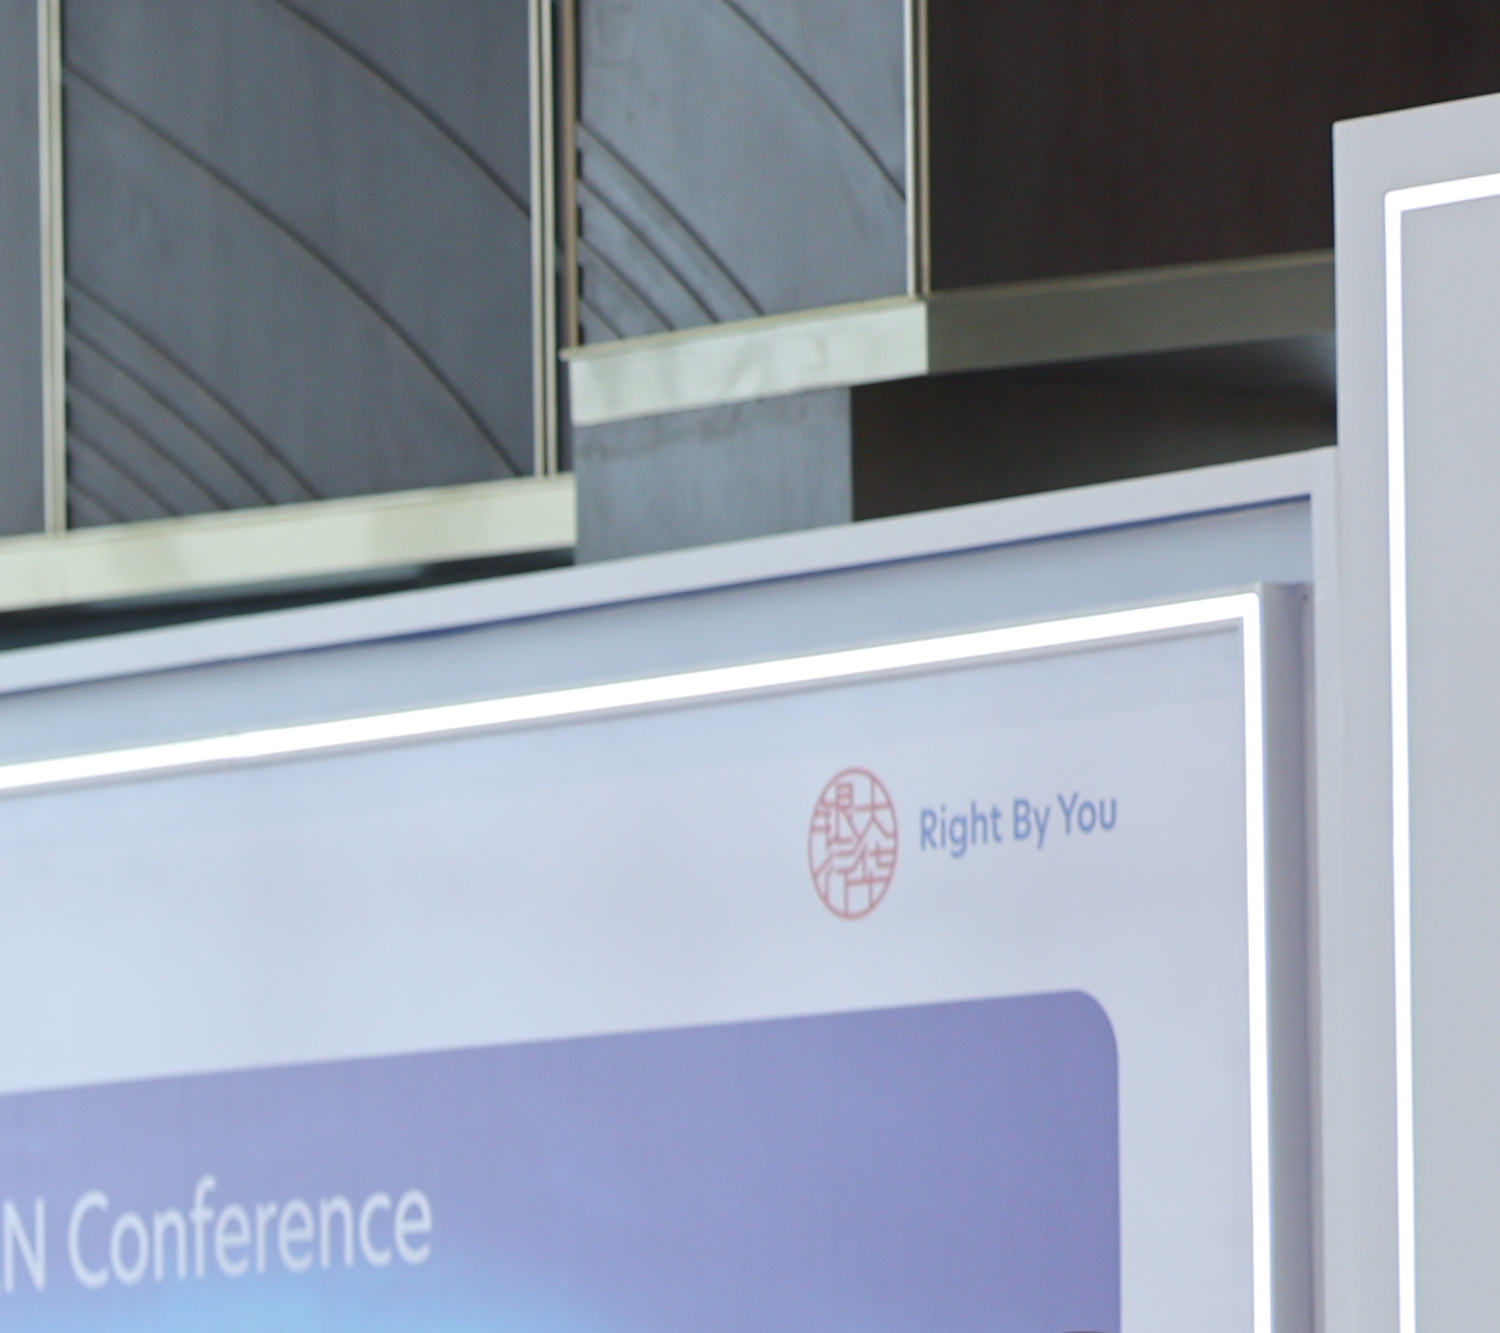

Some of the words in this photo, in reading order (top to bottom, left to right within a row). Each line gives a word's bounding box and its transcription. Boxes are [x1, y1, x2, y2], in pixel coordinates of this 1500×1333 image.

[919, 799, 1004, 858] Right
[1012, 797, 1051, 850] By
[1057, 791, 1117, 835] You
[67, 1173, 432, 1290] Conference
